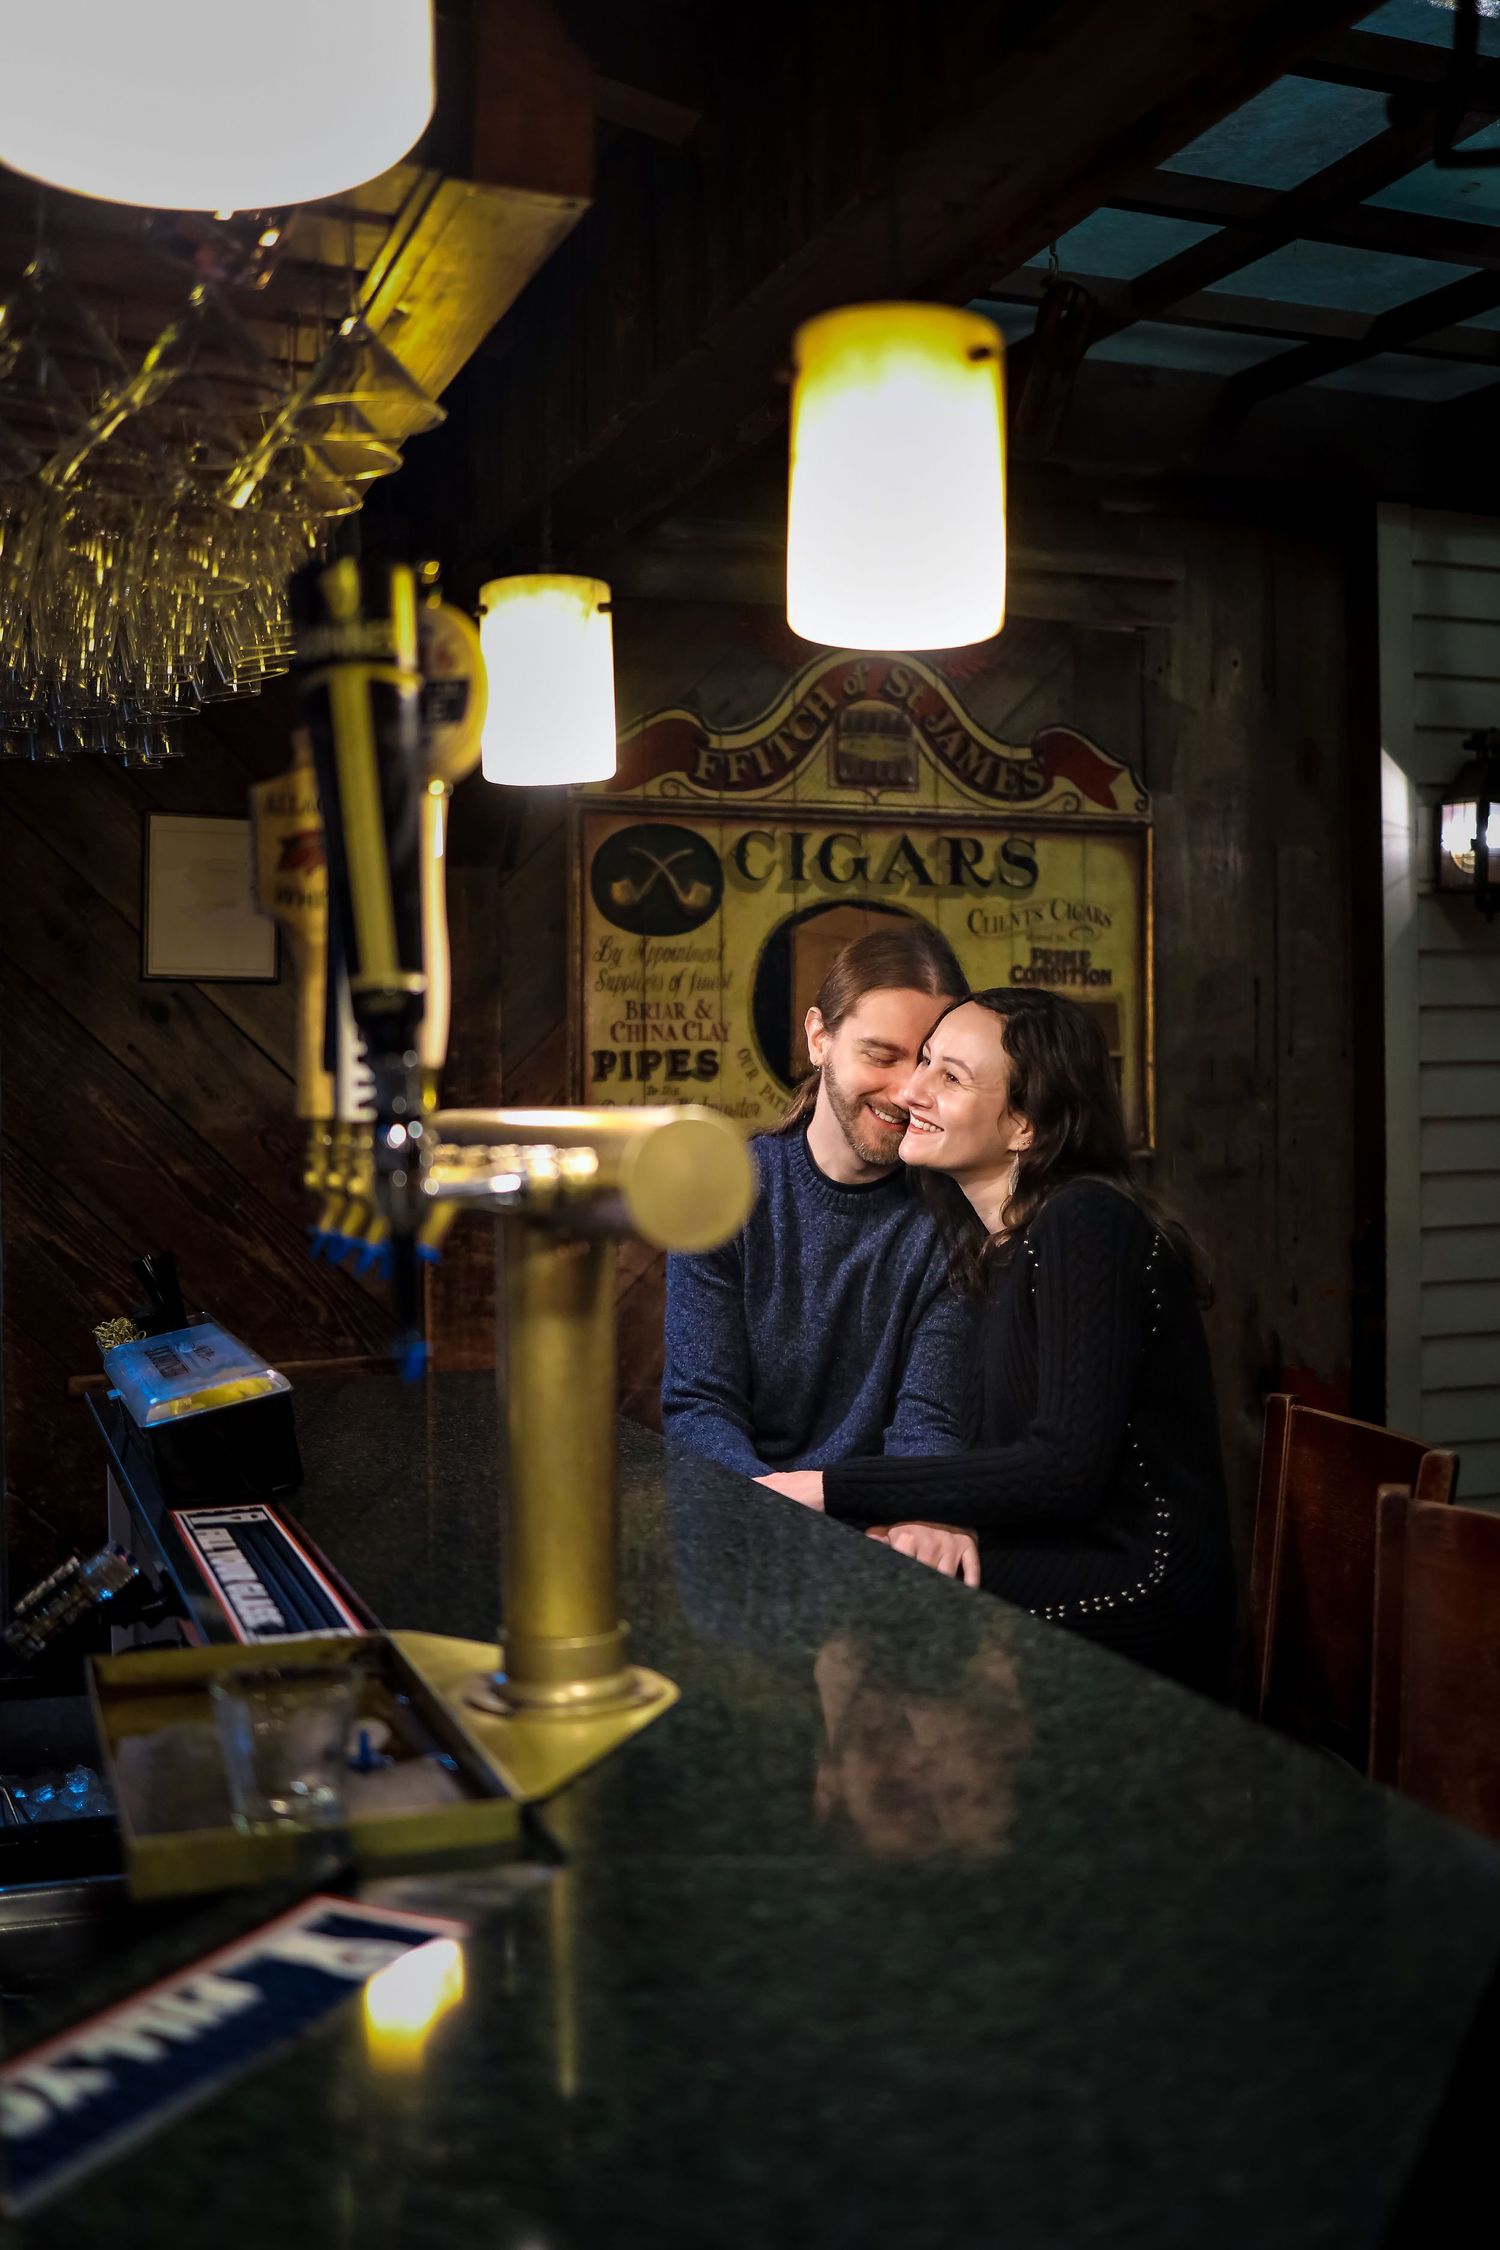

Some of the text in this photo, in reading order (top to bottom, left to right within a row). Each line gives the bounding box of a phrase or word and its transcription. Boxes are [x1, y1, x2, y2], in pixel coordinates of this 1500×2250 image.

[695, 685, 838, 784] FFITCH
[843, 663, 871, 696] of
[923, 707, 1046, 796] JAMES
[731, 829, 1040, 890] CIGARS
[593, 934, 623, 969] By
[625, 998, 713, 1021] BRIAR &
[609, 1020, 732, 1043] CHINA CLAY
[591, 1048, 720, 1083] PIPES
[737, 1047, 760, 1082] OUR
